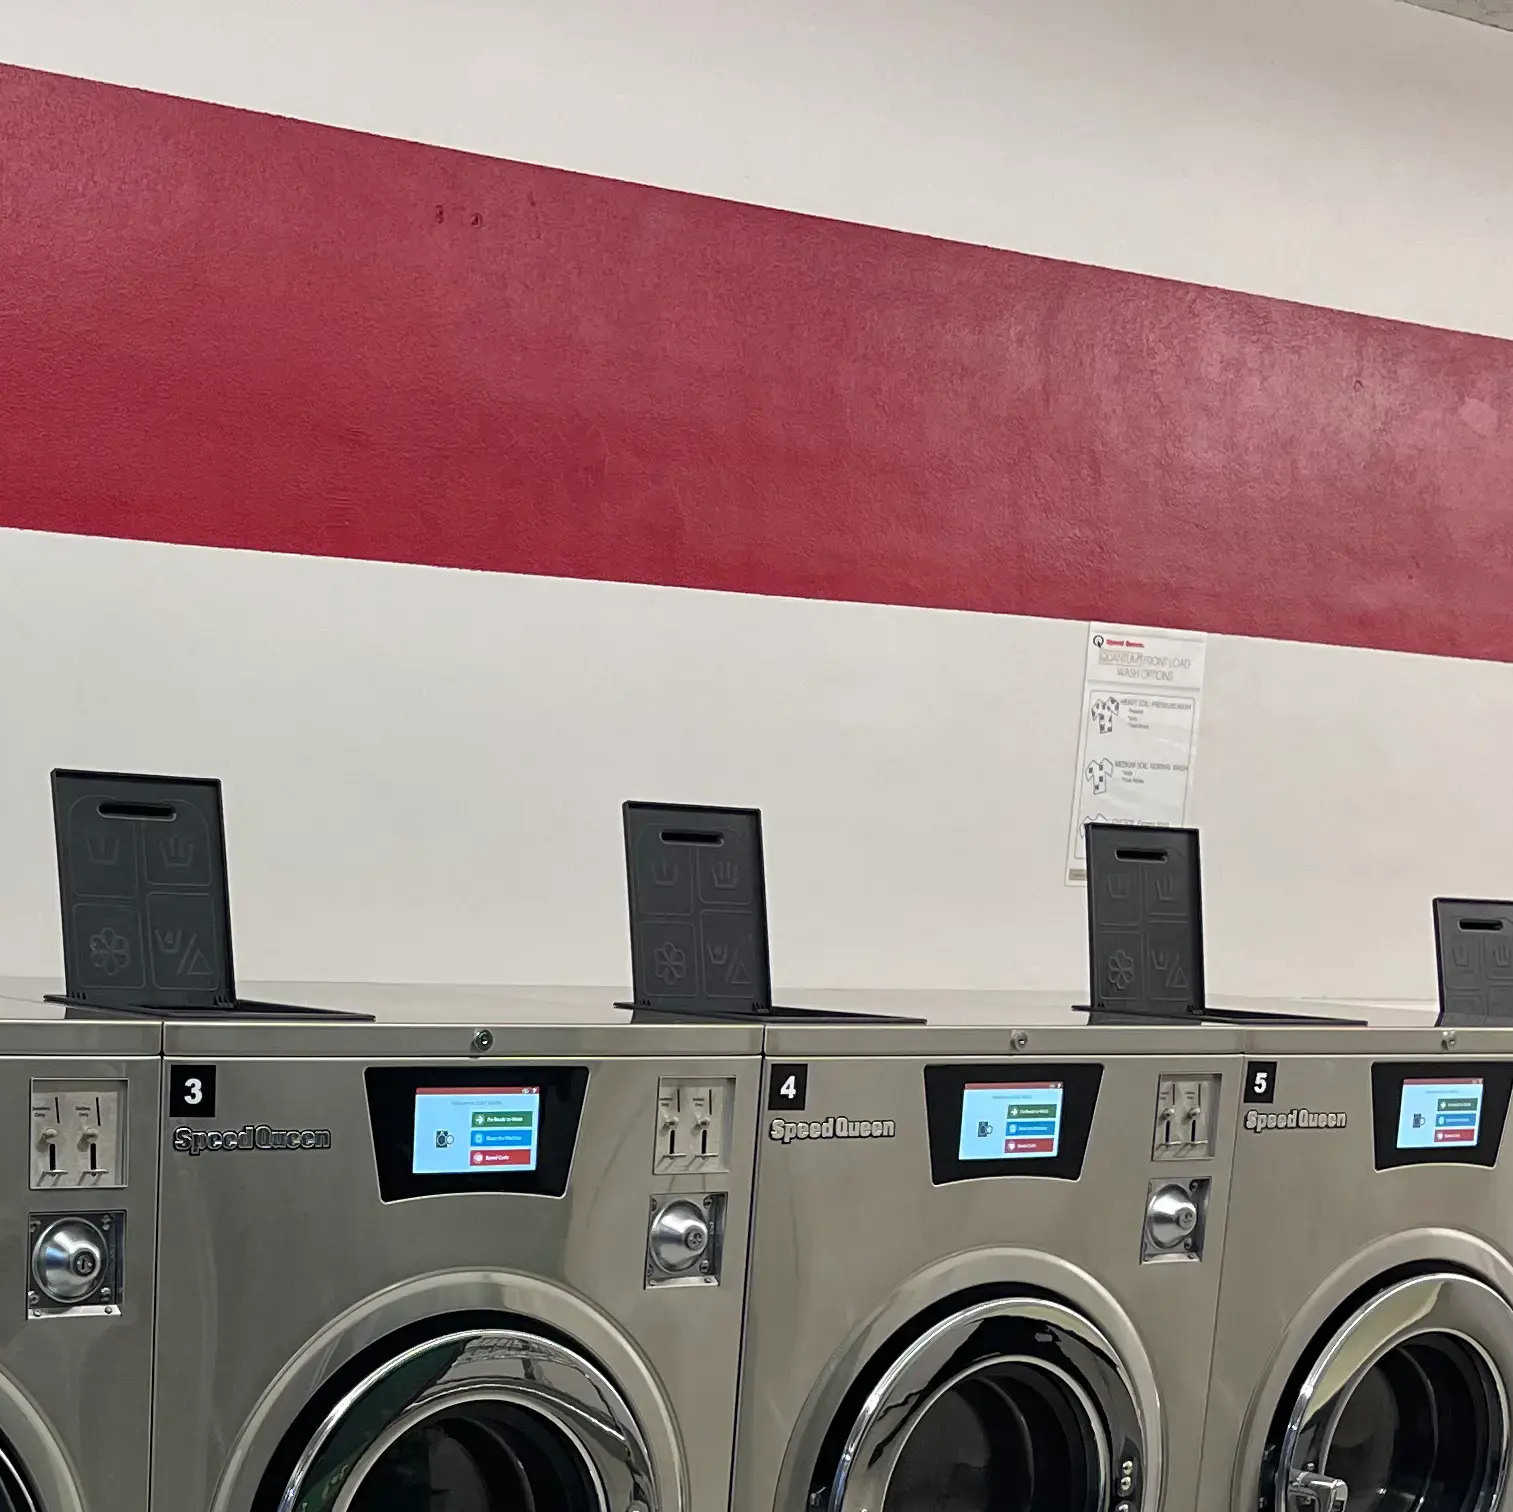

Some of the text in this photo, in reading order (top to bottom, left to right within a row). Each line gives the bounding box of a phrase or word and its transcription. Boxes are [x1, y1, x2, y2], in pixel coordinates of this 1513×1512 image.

[184, 1078, 203, 1104] 3
[780, 1075, 796, 1099] 4
[1253, 1072, 1268, 1094] 5
[769, 1116, 896, 1144] Speed Queen
[1244, 1108, 1348, 1133] Speed Queen
[173, 1125, 331, 1156] Speed Queen
